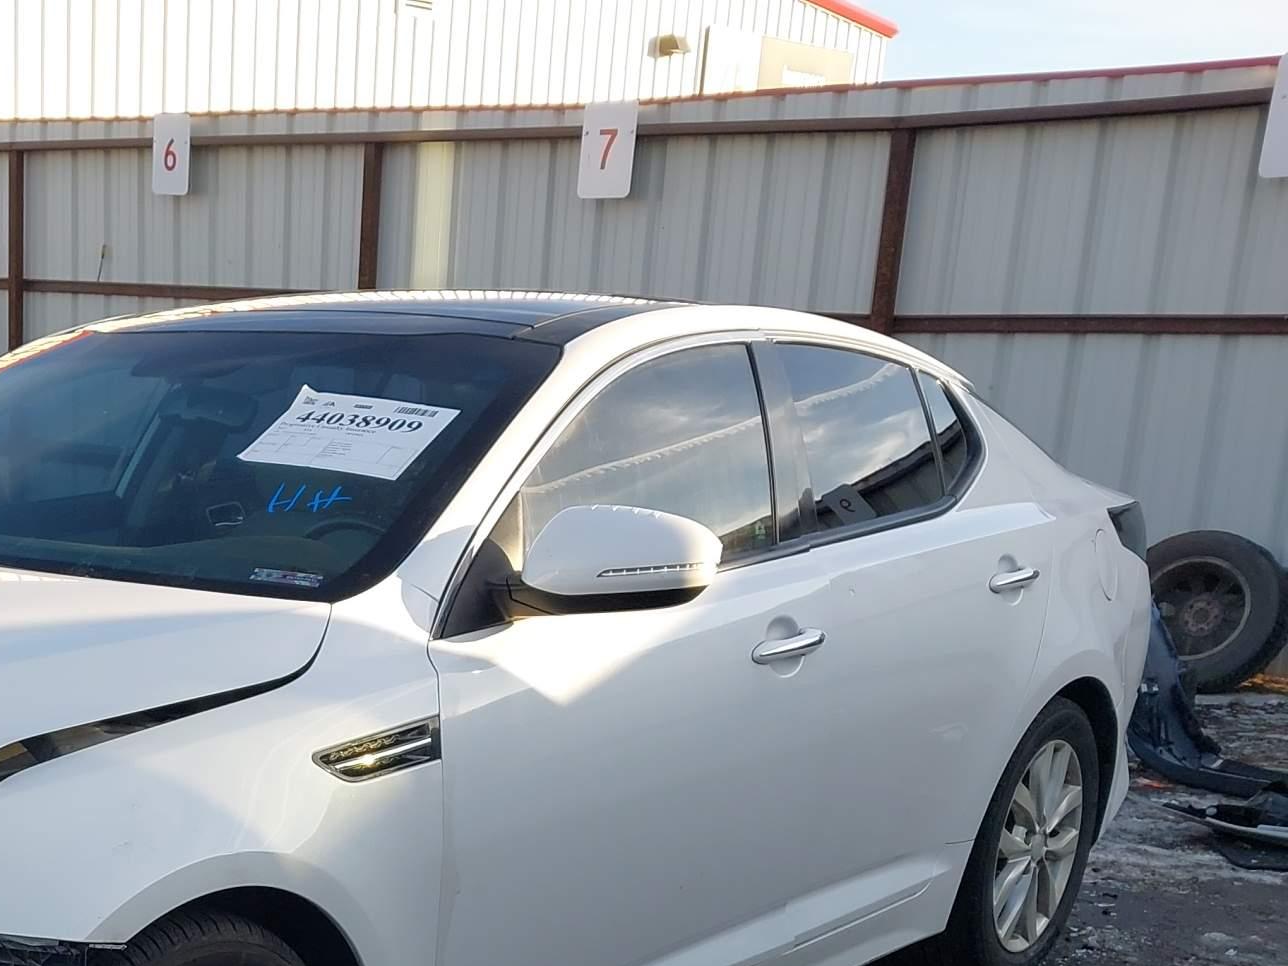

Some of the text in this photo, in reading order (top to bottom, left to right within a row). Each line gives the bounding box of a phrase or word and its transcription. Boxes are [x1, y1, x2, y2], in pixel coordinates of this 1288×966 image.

[164, 138, 177, 171] 6
[600, 128, 618, 170] 7
[296, 411, 423, 433] 44038909
